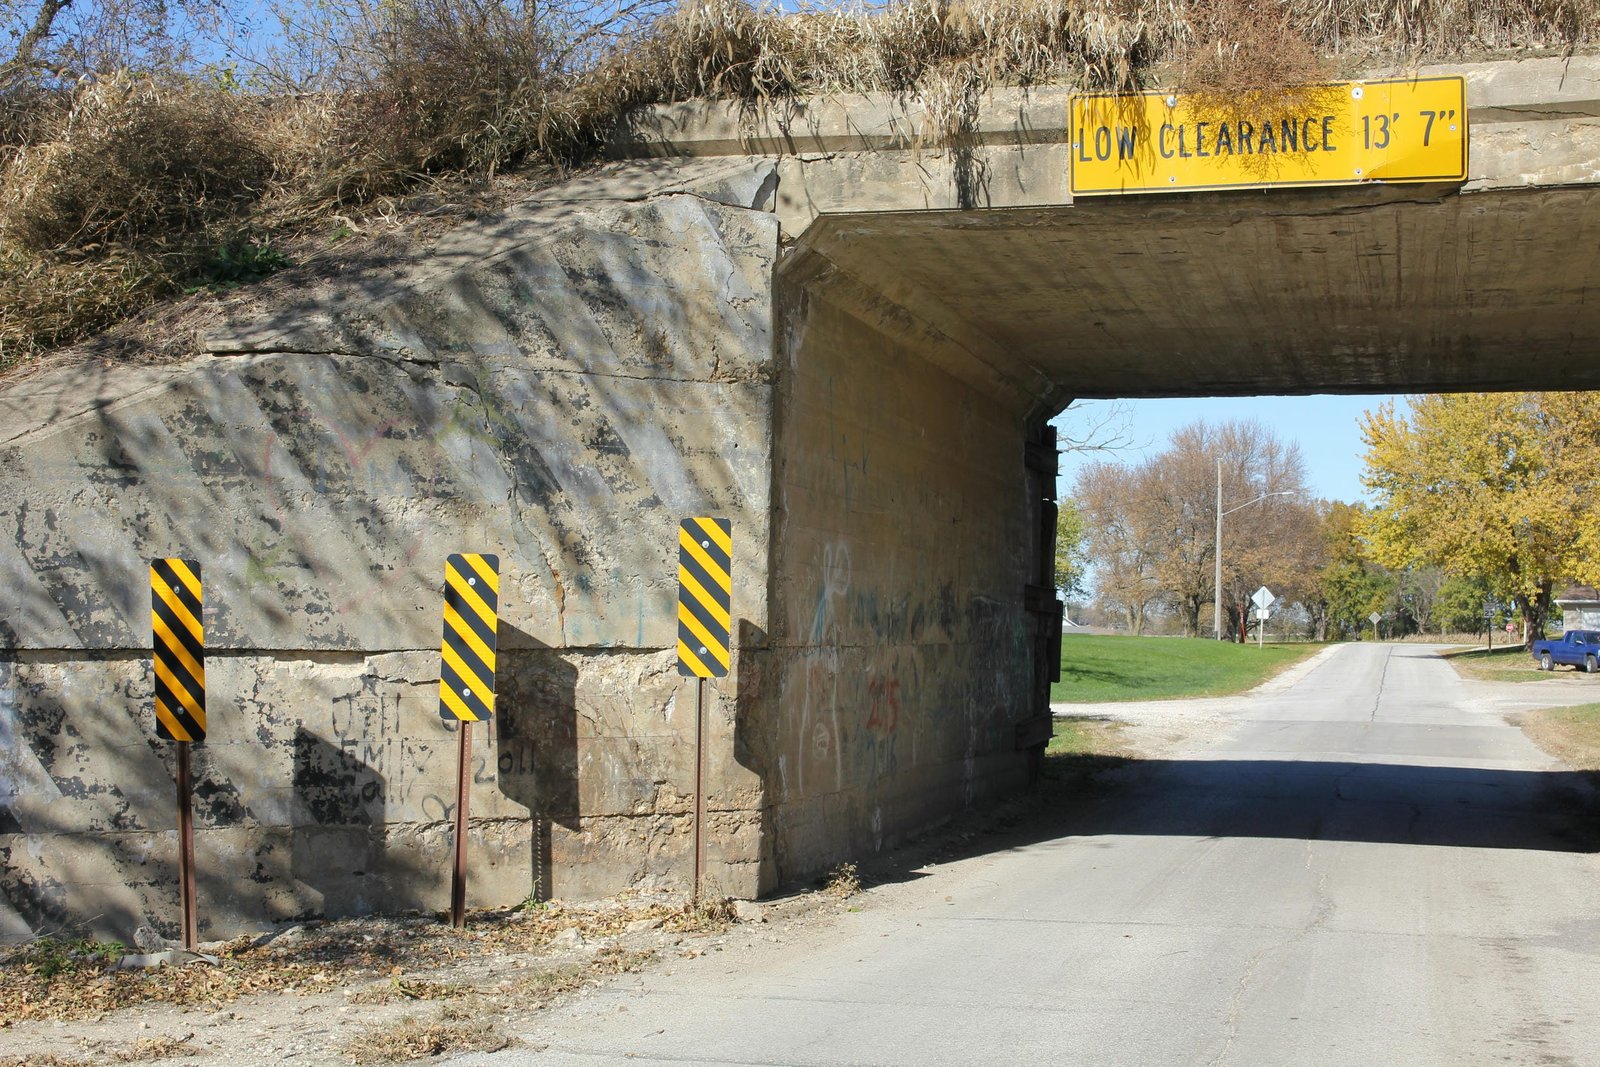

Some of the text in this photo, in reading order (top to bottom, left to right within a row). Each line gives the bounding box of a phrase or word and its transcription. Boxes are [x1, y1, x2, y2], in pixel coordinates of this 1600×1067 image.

[1079, 126, 1137, 162] LOW
[1159, 115, 1337, 159] CLEARANCE
[1361, 112, 1400, 150] 13'
